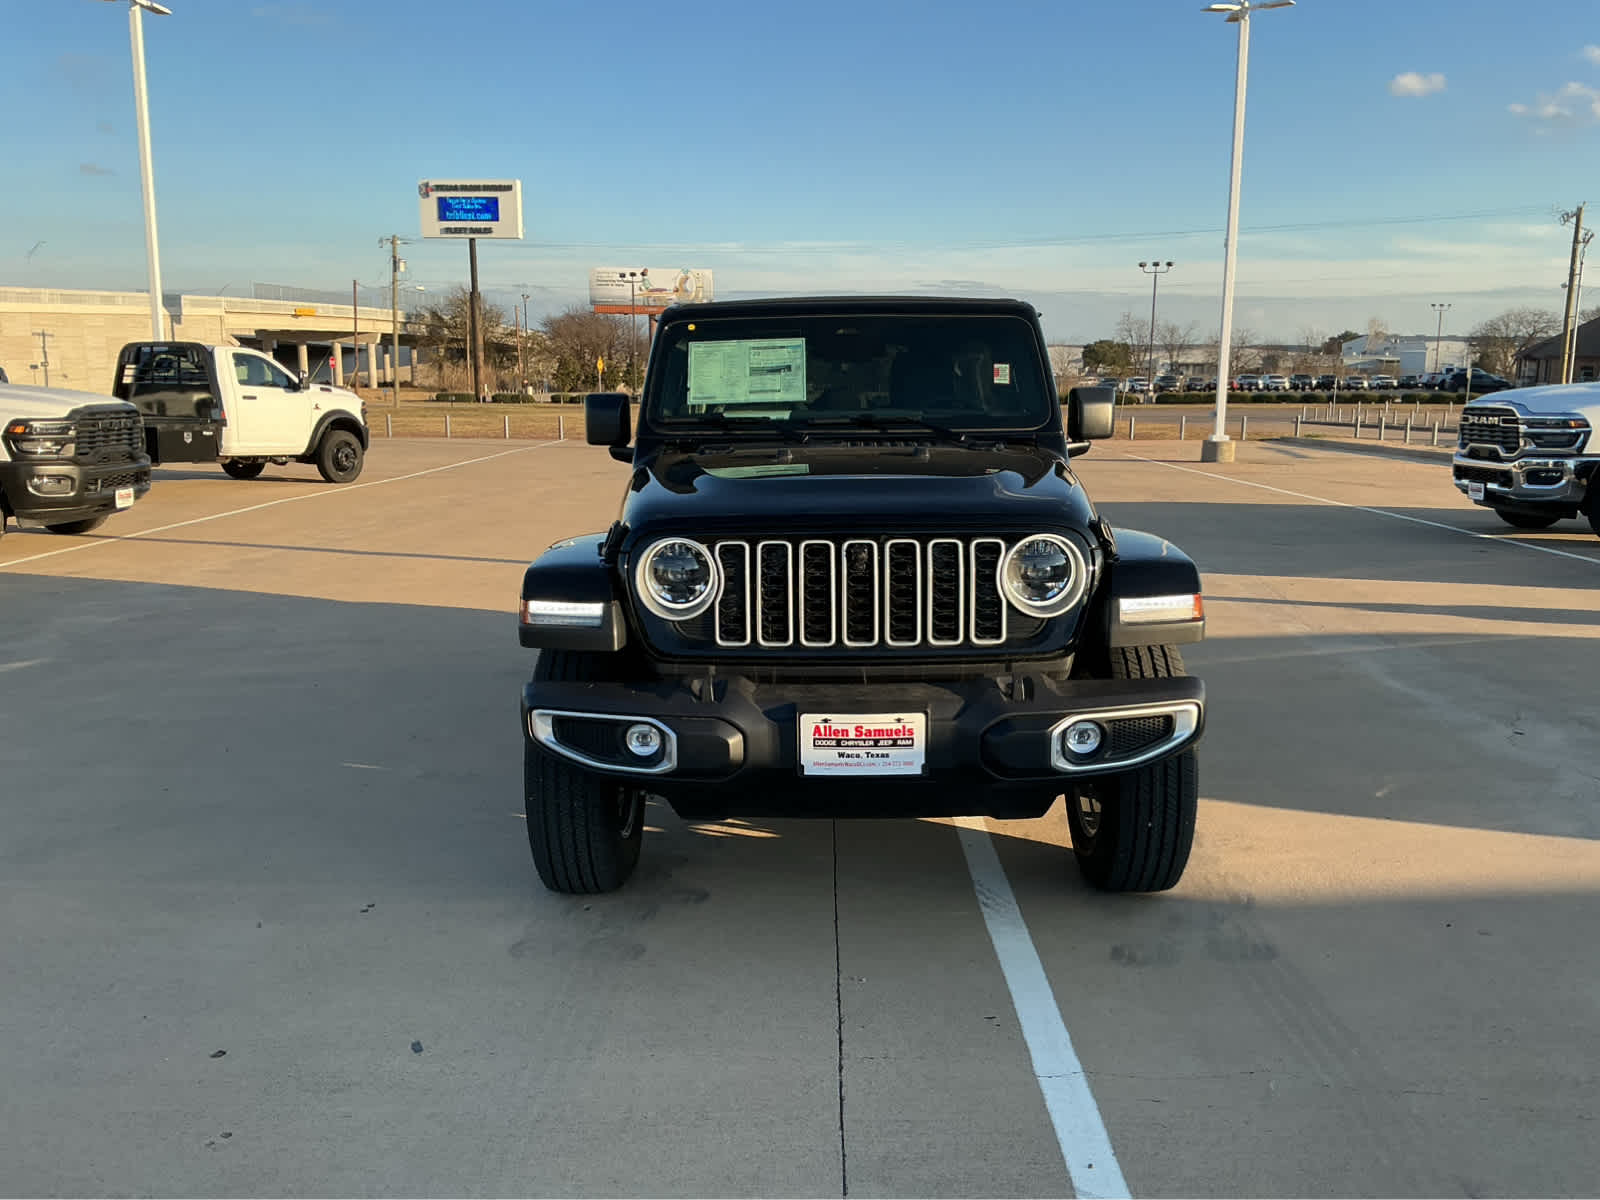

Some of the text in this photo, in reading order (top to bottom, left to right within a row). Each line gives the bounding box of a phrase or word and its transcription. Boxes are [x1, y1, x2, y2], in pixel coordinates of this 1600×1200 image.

[1470, 415, 1499, 424] RAM
[813, 724, 915, 738] Allen Samuels
[837, 751, 890, 759] Waco, Texas
